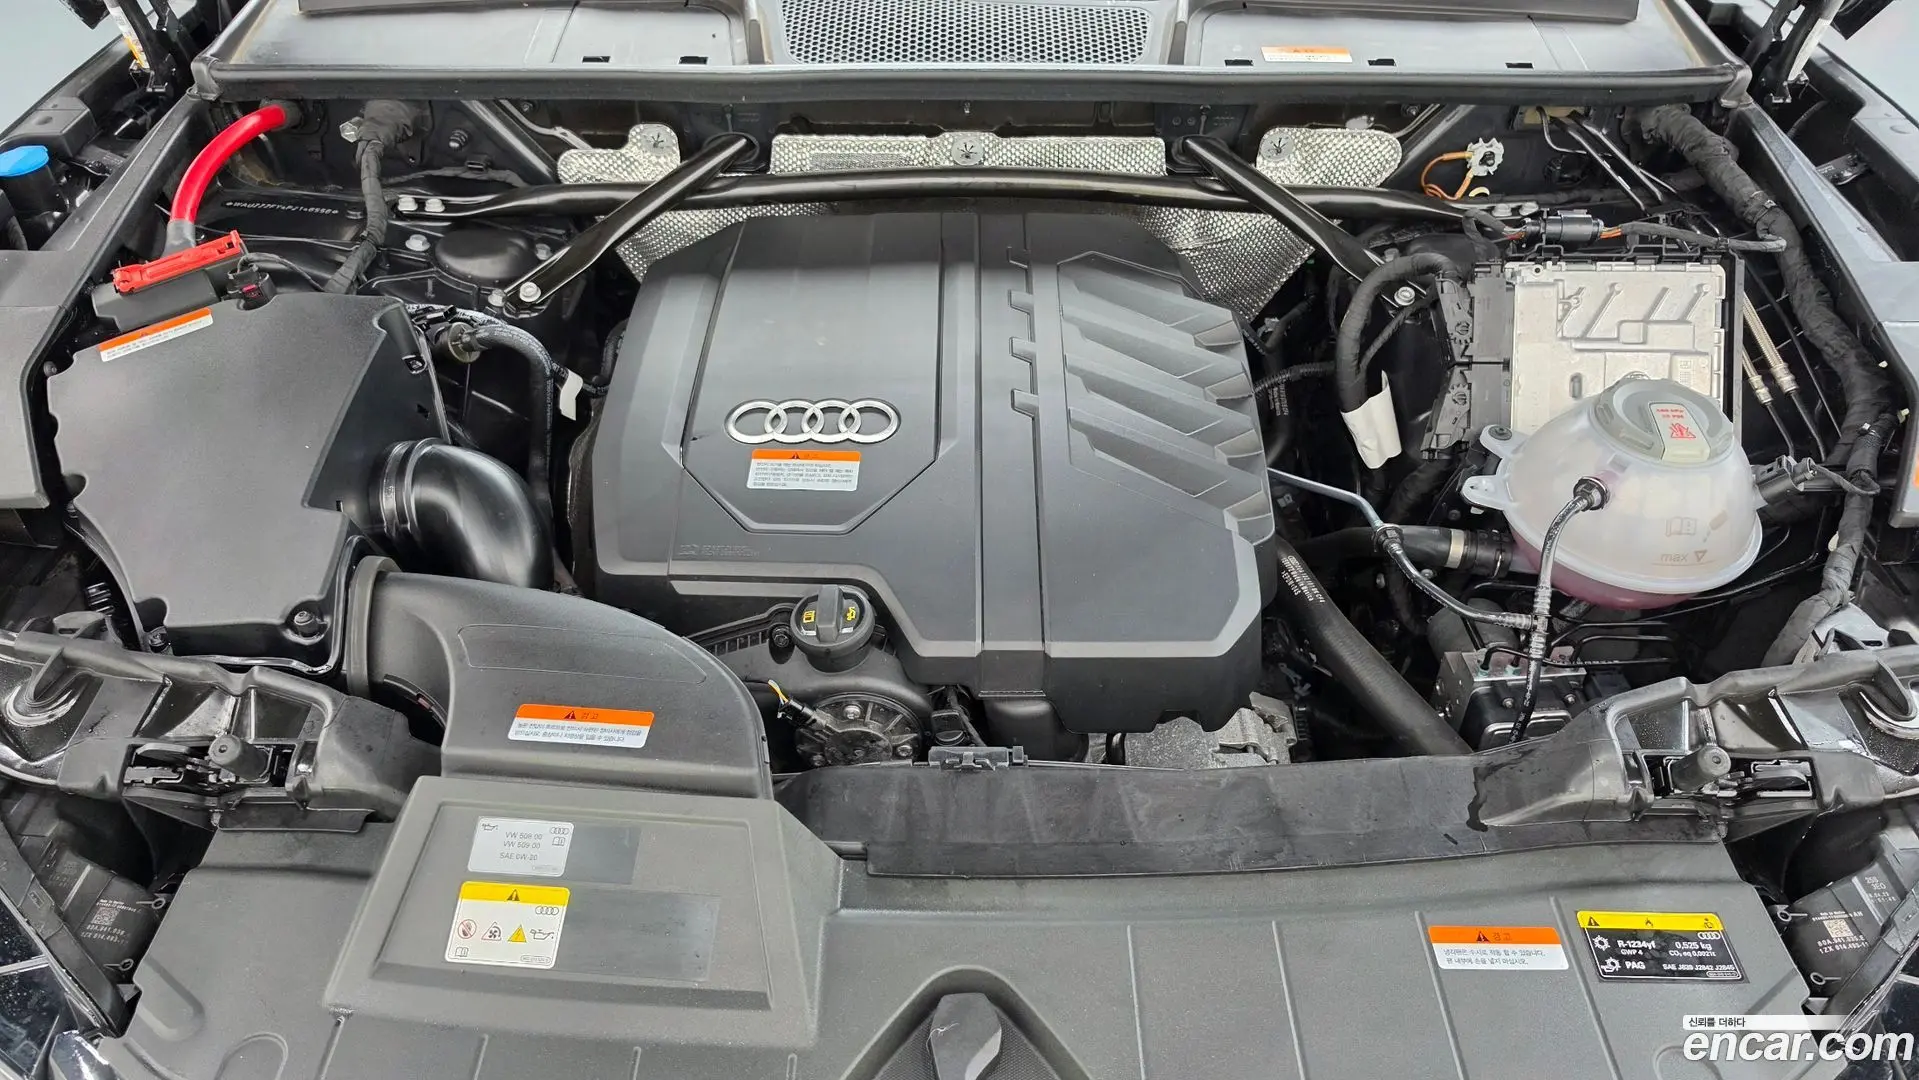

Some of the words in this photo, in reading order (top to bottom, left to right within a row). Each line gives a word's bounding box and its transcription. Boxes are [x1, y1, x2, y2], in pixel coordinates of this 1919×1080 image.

[1660, 553, 1688, 562] max
[500, 852, 514, 860] SAE
[1617, 940, 1656, 949] R-1234yf
[1675, 941, 1699, 950] 0,525
[1700, 942, 1713, 951] kg
[1625, 961, 1646, 970] PAG
